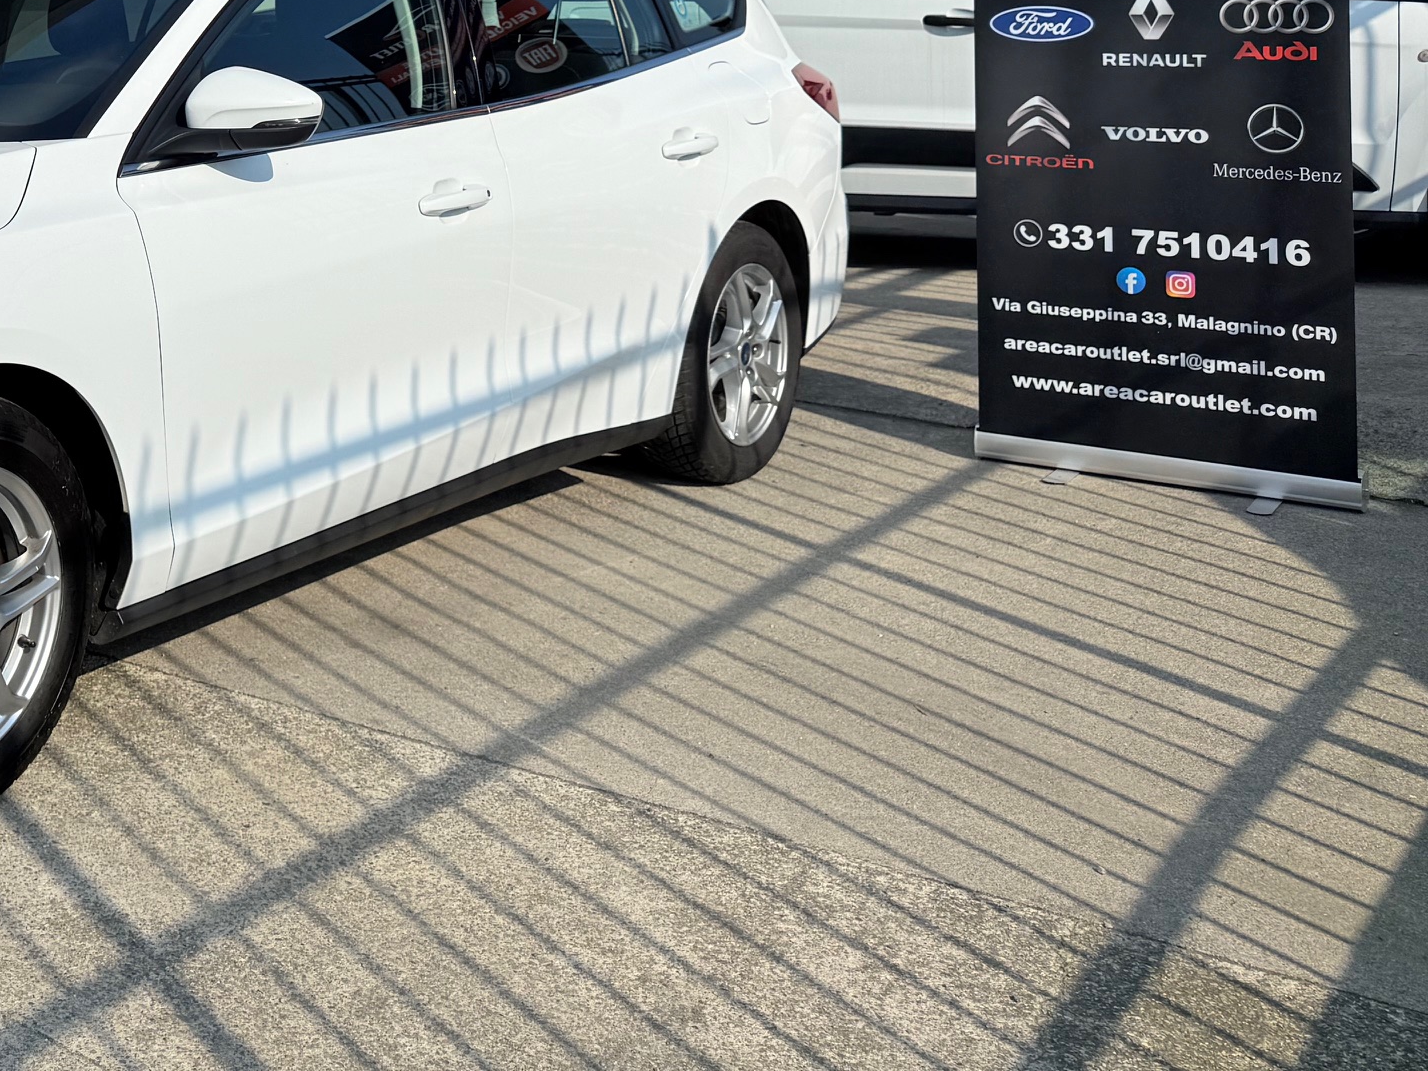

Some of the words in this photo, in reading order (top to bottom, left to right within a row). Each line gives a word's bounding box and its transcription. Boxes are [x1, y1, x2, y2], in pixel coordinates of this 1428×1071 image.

[1009, 10, 1072, 37] Ford
[1101, 52, 1207, 68] RENAULT
[1233, 41, 1318, 61] Audi
[1101, 126, 1209, 144] VOLVO
[1212, 163, 1342, 184] Mercedes-Benz
[1047, 222, 1114, 253] 331
[1131, 228, 1311, 267] 7510416
[991, 297, 1022, 313] Via
[1026, 300, 1138, 325] Giuseppina
[1141, 311, 1172, 328] 33,
[1177, 313, 1286, 338] Malagnino
[1291, 323, 1338, 345] (CR)
[1003, 336, 1326, 383] areacaroutlet.srl@gmail.com
[1011, 373, 1318, 422] www.areacaroutlet.com
